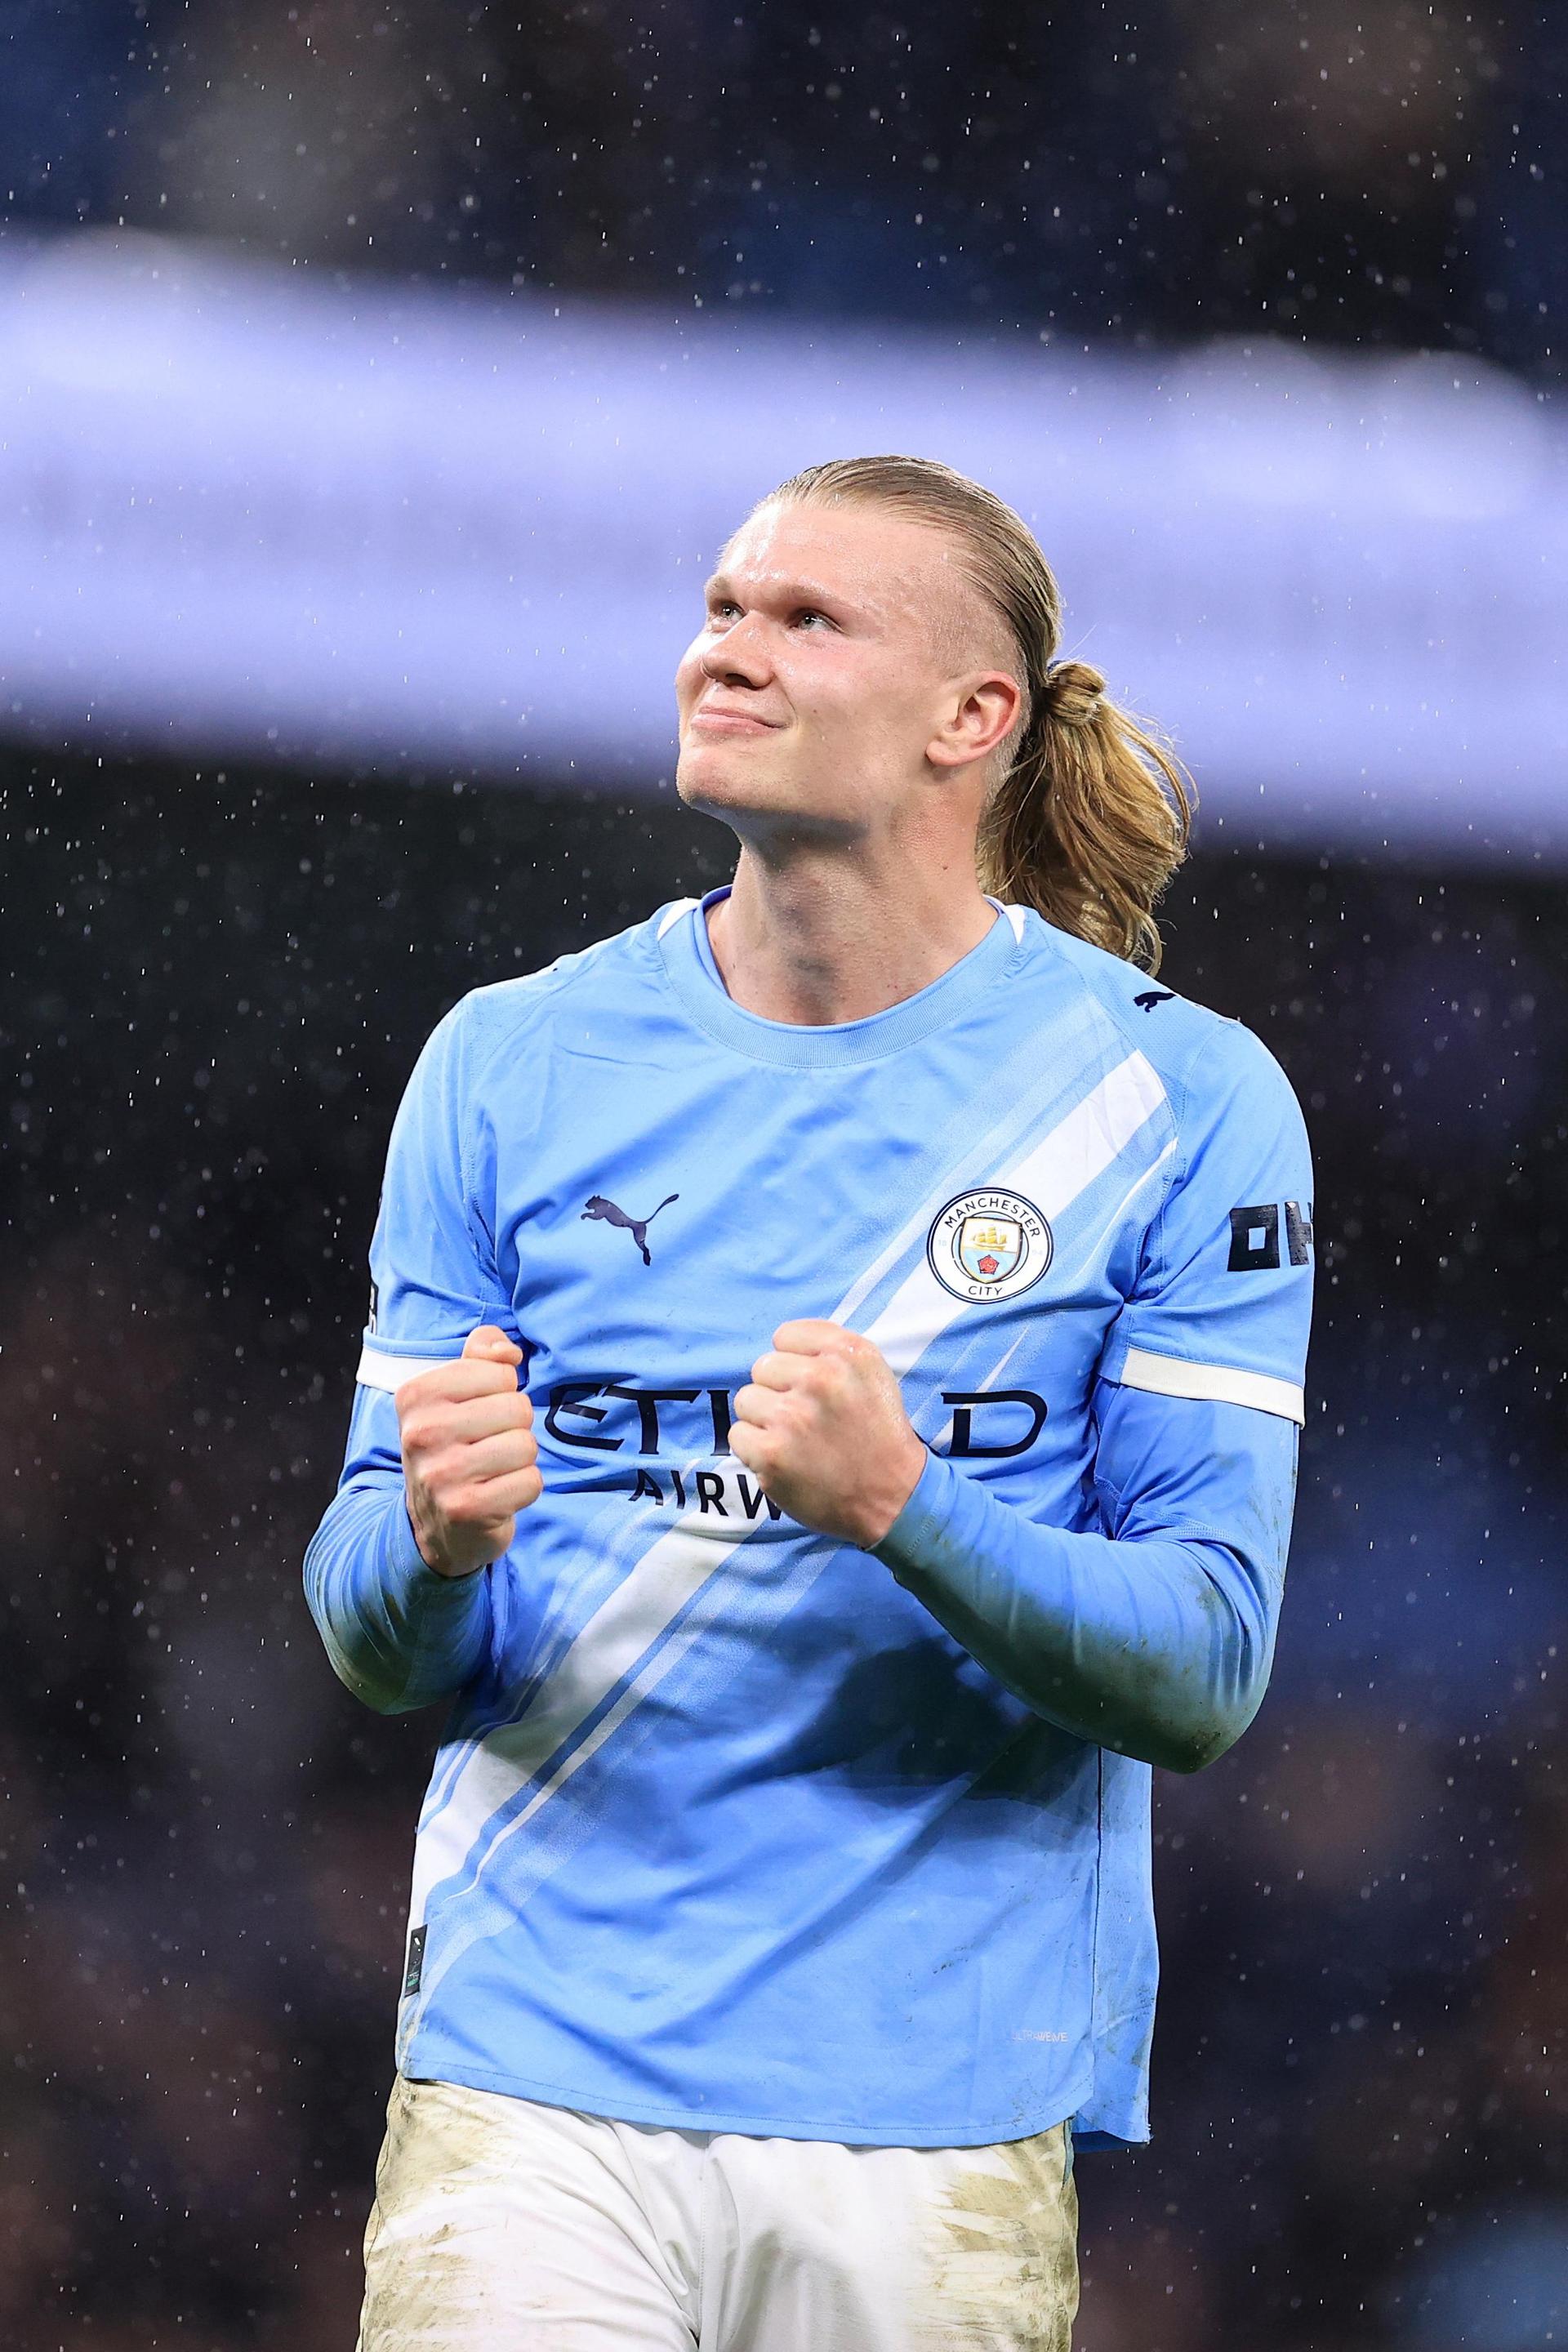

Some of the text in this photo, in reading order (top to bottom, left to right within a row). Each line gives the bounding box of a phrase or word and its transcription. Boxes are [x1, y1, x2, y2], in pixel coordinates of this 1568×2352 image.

[944, 1197, 1040, 1237] MANCHESTER
[1227, 1201, 1313, 1272] OK
[968, 1285, 1003, 1296] CITY
[544, 1381, 1048, 1458] ETID
[628, 1468, 782, 1521] AIRW
